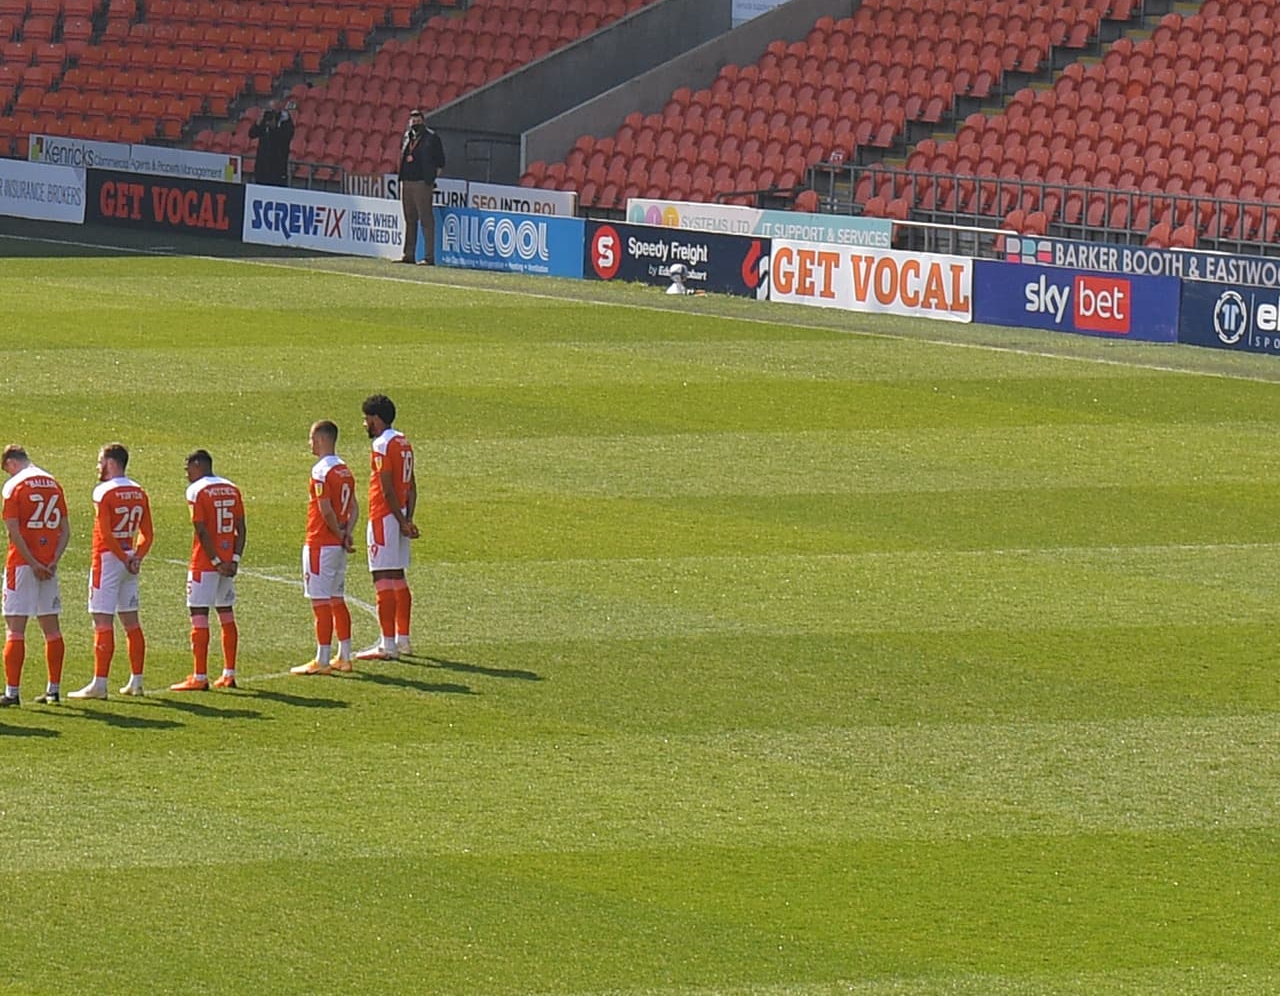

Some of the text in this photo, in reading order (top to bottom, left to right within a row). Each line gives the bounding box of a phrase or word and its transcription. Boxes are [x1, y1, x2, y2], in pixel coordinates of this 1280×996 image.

[44, 139, 94, 167] Kenricks
[4, 178, 45, 202] INSURANCE
[48, 183, 82, 206] BROKERS
[100, 180, 229, 230] GET VOCAL
[500, 197, 530, 212] INTO
[351, 210, 398, 229] HERE WHEN
[681, 216, 750, 234] SYSTEMS LTD
[774, 223, 824, 242] SUPPORT
[827, 229, 835, 242] &
[837, 228, 888, 247] SERVICES
[351, 226, 402, 246] YOU NEED US
[442, 213, 549, 261] ALLCOOL
[628, 236, 708, 265] Speedy Freight
[648, 264, 657, 276] by
[773, 247, 970, 312] GET VOCAL
[1055, 242, 1280, 288] BARKER BOOTH & EASTWO
[1025, 274, 1124, 324] sky bet
[401, 451, 413, 483] 19
[26, 494, 61, 529] 26
[340, 483, 351, 516] 9
[111, 506, 144, 539] 20
[214, 499, 236, 534] 15
